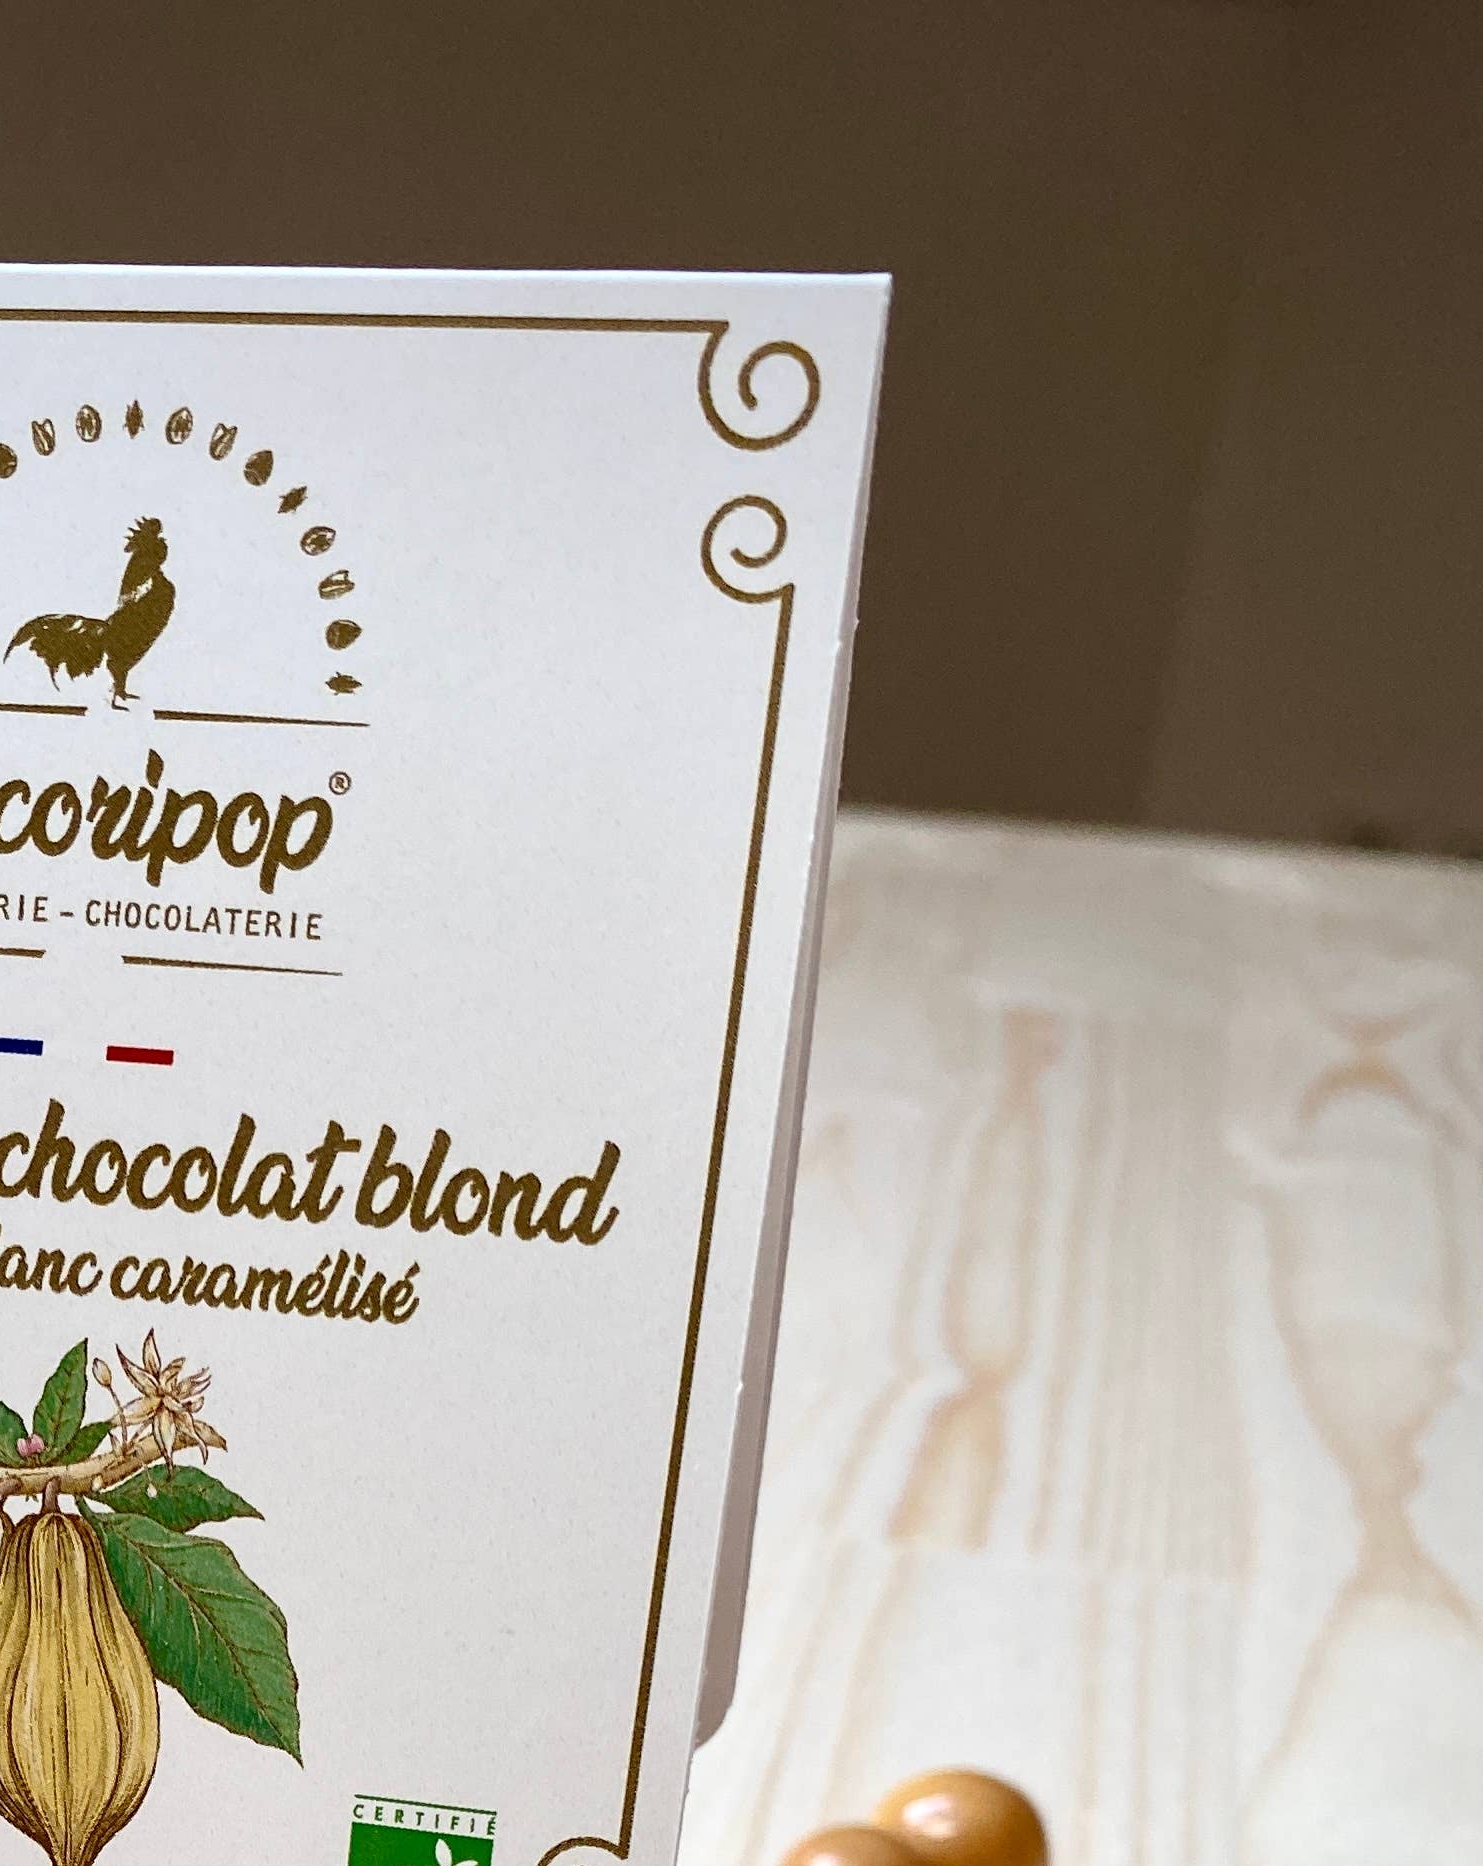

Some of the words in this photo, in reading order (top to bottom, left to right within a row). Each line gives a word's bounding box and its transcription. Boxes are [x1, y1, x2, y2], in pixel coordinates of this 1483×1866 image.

[85, 899, 323, 941] CHOCOLATERIE
[354, 1123, 621, 1246] blond
[110, 1248, 421, 1325] caramélisé
[352, 1803, 496, 1836] CERTIFIÉ
